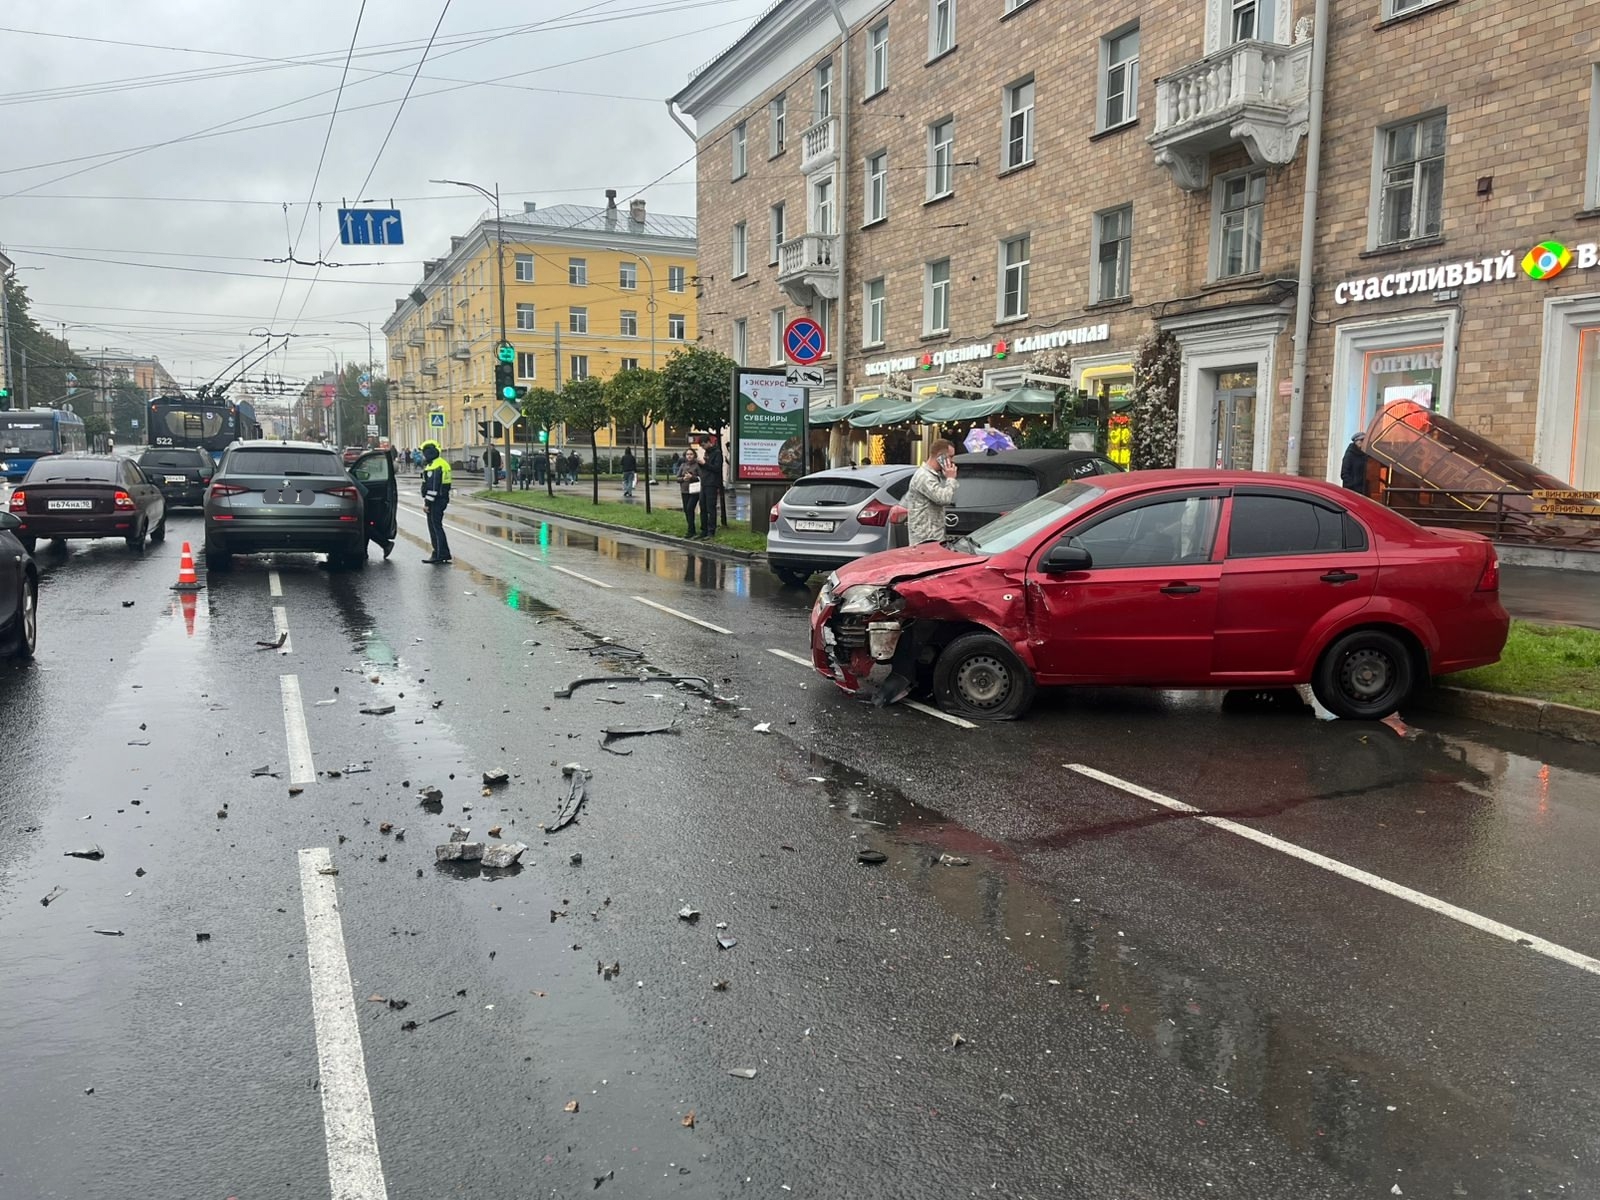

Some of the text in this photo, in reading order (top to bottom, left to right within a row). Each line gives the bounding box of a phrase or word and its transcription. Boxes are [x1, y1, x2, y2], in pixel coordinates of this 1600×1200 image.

[1577, 243, 1600, 269] в
[865, 323, 1109, 378] ЭКСКУРСИИ СУВЕНИРЫ КАЛИТОЧНАЯ
[744, 414, 788, 422] СУВЕНИРЫ
[156, 437, 173, 445] 522
[1540, 505, 1584, 513] СУВЕНИРЫ
